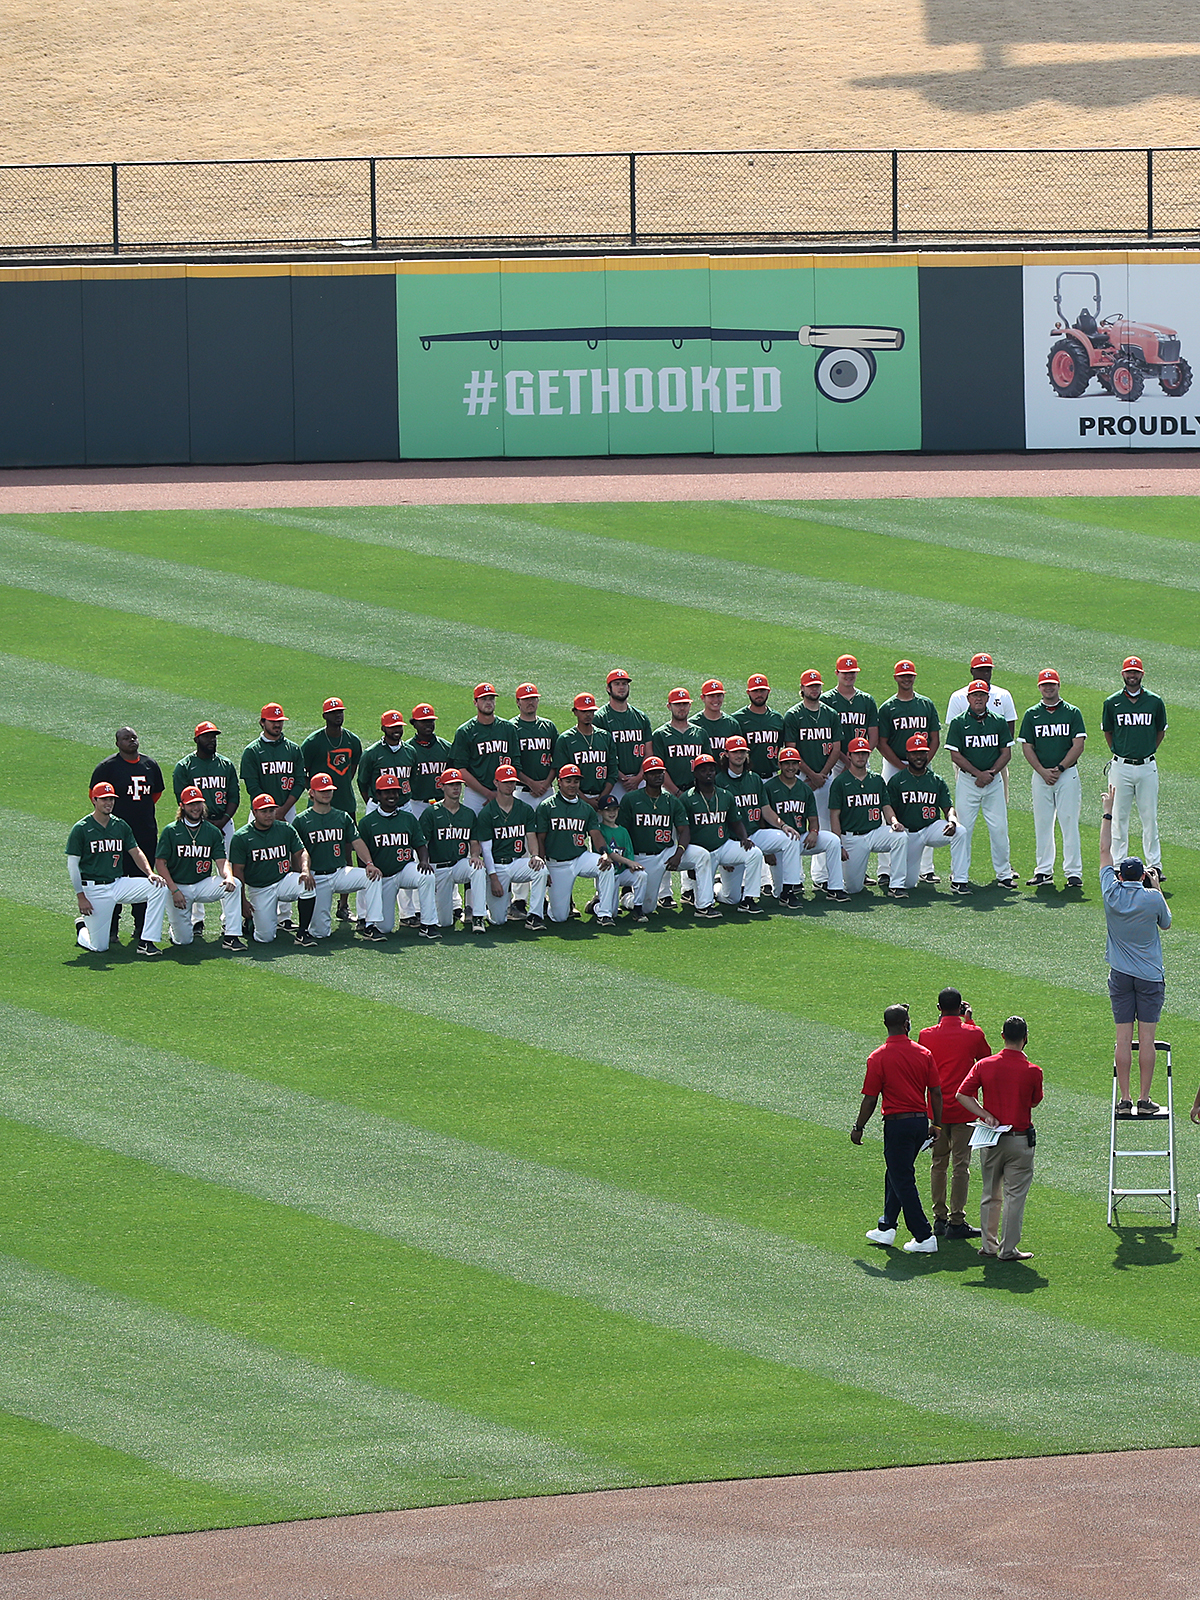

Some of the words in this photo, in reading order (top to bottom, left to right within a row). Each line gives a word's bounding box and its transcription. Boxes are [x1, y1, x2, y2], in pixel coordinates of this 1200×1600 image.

[462, 365, 782, 416] #GETHOOKED
[893, 716, 927, 730] FAMU
[1116, 713, 1153, 726] FAMU
[611, 729, 643, 743] FAMU
[746, 730, 779, 744] FAMU
[800, 728, 832, 740] FAMU
[1034, 723, 1070, 738] FAMU
[477, 740, 508, 755] FAMU
[519, 738, 552, 751] FAMU
[965, 733, 999, 748] FAMU
[573, 750, 606, 765] FAMU
[668, 744, 702, 758] FAMU
[261, 761, 294, 775] FAMU
[417, 762, 447, 775] AMU
[596, 766, 607, 779] 21
[193, 776, 226, 789] FAMU
[734, 793, 758, 807] AMU
[847, 794, 880, 807] FAMU
[901, 791, 937, 805] FAMU
[775, 800, 806, 814] FAMU
[922, 806, 936, 819] 26
[635, 813, 670, 827] FAMU
[694, 811, 727, 825] FAMU
[748, 808, 761, 821] 20
[868, 808, 880, 821] 16
[494, 824, 525, 839] FAMU
[550, 818, 585, 831] FAMU
[308, 828, 343, 844] FAMU
[374, 833, 409, 847] FAMU
[437, 827, 471, 840] FAMU
[572, 833, 585, 846] 15
[655, 829, 671, 843] 25
[90, 839, 123, 853] FAMU
[177, 845, 211, 858] FAMU
[252, 845, 287, 861] FAMU
[333, 844, 341, 857] 5
[458, 842, 466, 855] 2
[514, 840, 523, 853] 9
[112, 854, 120, 868] 7
[397, 848, 412, 861] 33
[196, 860, 211, 873] 29
[277, 860, 290, 873] 19
